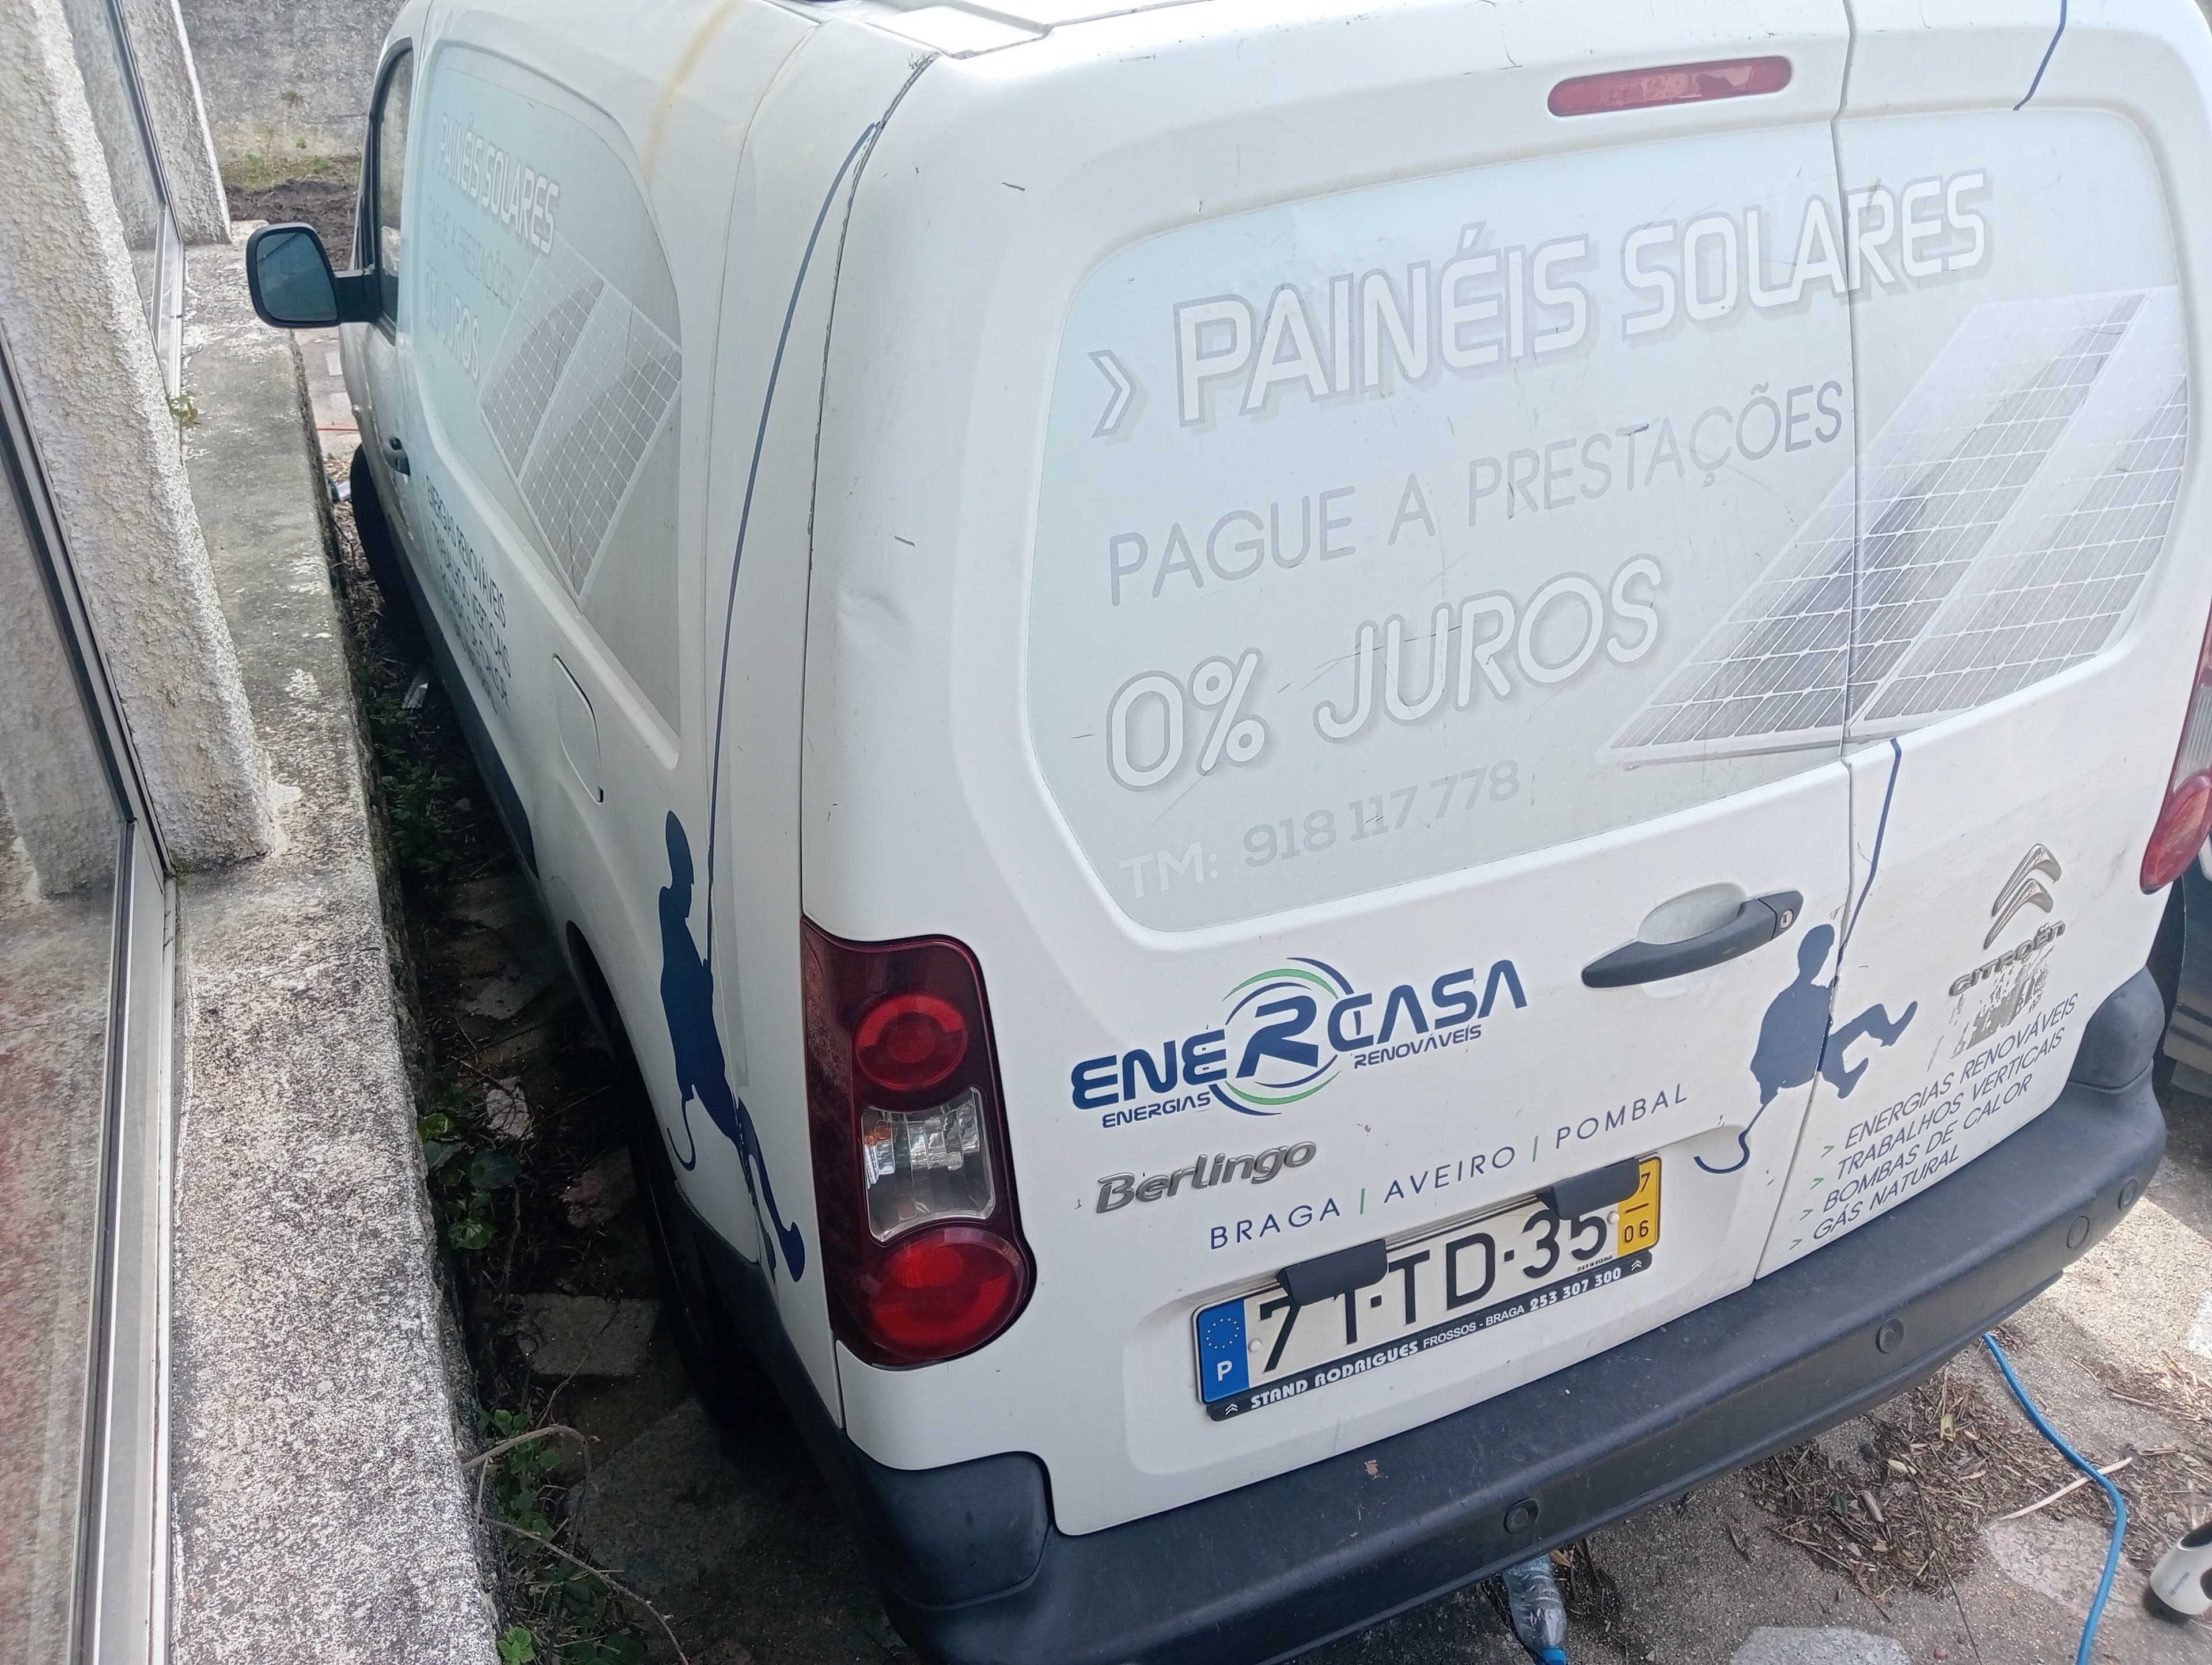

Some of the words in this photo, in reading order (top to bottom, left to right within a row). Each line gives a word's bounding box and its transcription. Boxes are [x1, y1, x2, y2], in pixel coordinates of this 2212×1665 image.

[480, 142, 560, 255] SOLARES
[1172, 221, 1591, 428] PAINÉIS
[1620, 168, 1987, 342] SOLARES
[1108, 485, 1356, 607] PAGUE
[1387, 473, 1437, 546] A
[1468, 380, 1843, 528] PRESTAÇÕES
[1106, 647, 1270, 792] 0%
[1313, 553, 1665, 744] JUROS
[1119, 842, 1221, 899] TM:
[1243, 809, 1338, 868] 918
[1349, 784, 1419, 843] 117
[1430, 760, 1521, 820] 778
[1101, 1090, 1211, 1129] ENERGIAS
[1353, 1023, 1482, 1069] RENOVÁVEIS
[1838, 1092, 1964, 1180] TRABALHOS
[1972, 1027, 2065, 1101] VERTICAIS
[1844, 1072, 1955, 1150] ENERGIAS
[1960, 992, 2078, 1084] RENOVÁVEIS
[1096, 1140, 1317, 1213] Berlingo
[1210, 1197, 1341, 1250] BRAGA
[1384, 1146, 1516, 1204] AVEIRO
[1555, 1083, 1688, 1150] POMBAL
[1813, 1201, 1863, 1240] GÁS
[1869, 1143, 1959, 1211] NATURAL
[1823, 1143, 1920, 1213] BOMBAS
[1925, 1120, 1959, 1155] DE
[1963, 1074, 2033, 1129] CALOR
[1624, 1220, 1649, 1243] 06
[1217, 1360, 1233, 1382] P
[1251, 1380, 1309, 1410] STAND
[1315, 1341, 1419, 1387] RODRIGUES
[1423, 1322, 1476, 1349] FROSSOS
[1485, 1304, 1525, 1326] BRAGA
[1529, 1290, 1558, 1311] 253
[1562, 1279, 1589, 1299] 307
[1594, 1267, 1622, 1288] 300
